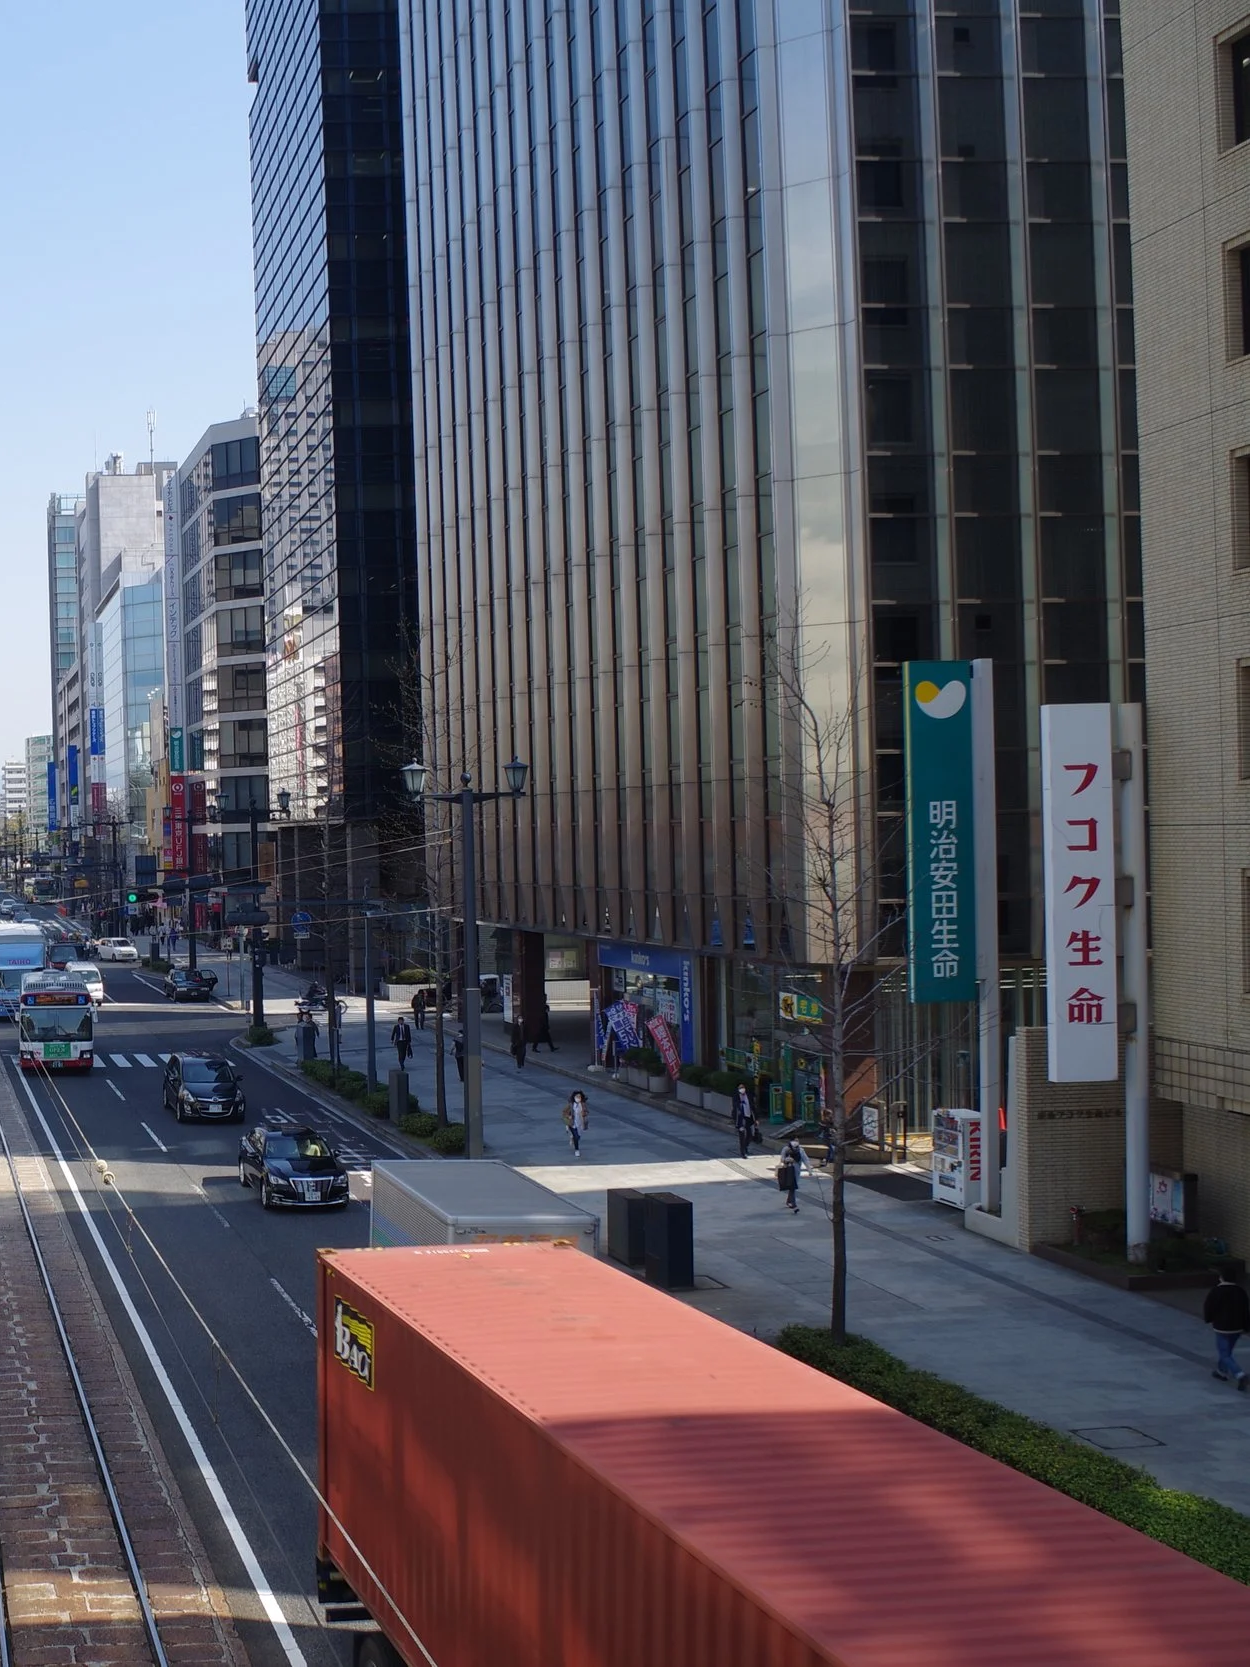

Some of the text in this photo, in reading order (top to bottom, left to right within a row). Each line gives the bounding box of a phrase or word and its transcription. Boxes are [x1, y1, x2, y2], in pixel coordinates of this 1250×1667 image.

[929, 800, 960, 979] 明治安田生命
[1063, 763, 1106, 1025] フコク生命
[969, 1121, 981, 1181] KIRIN
